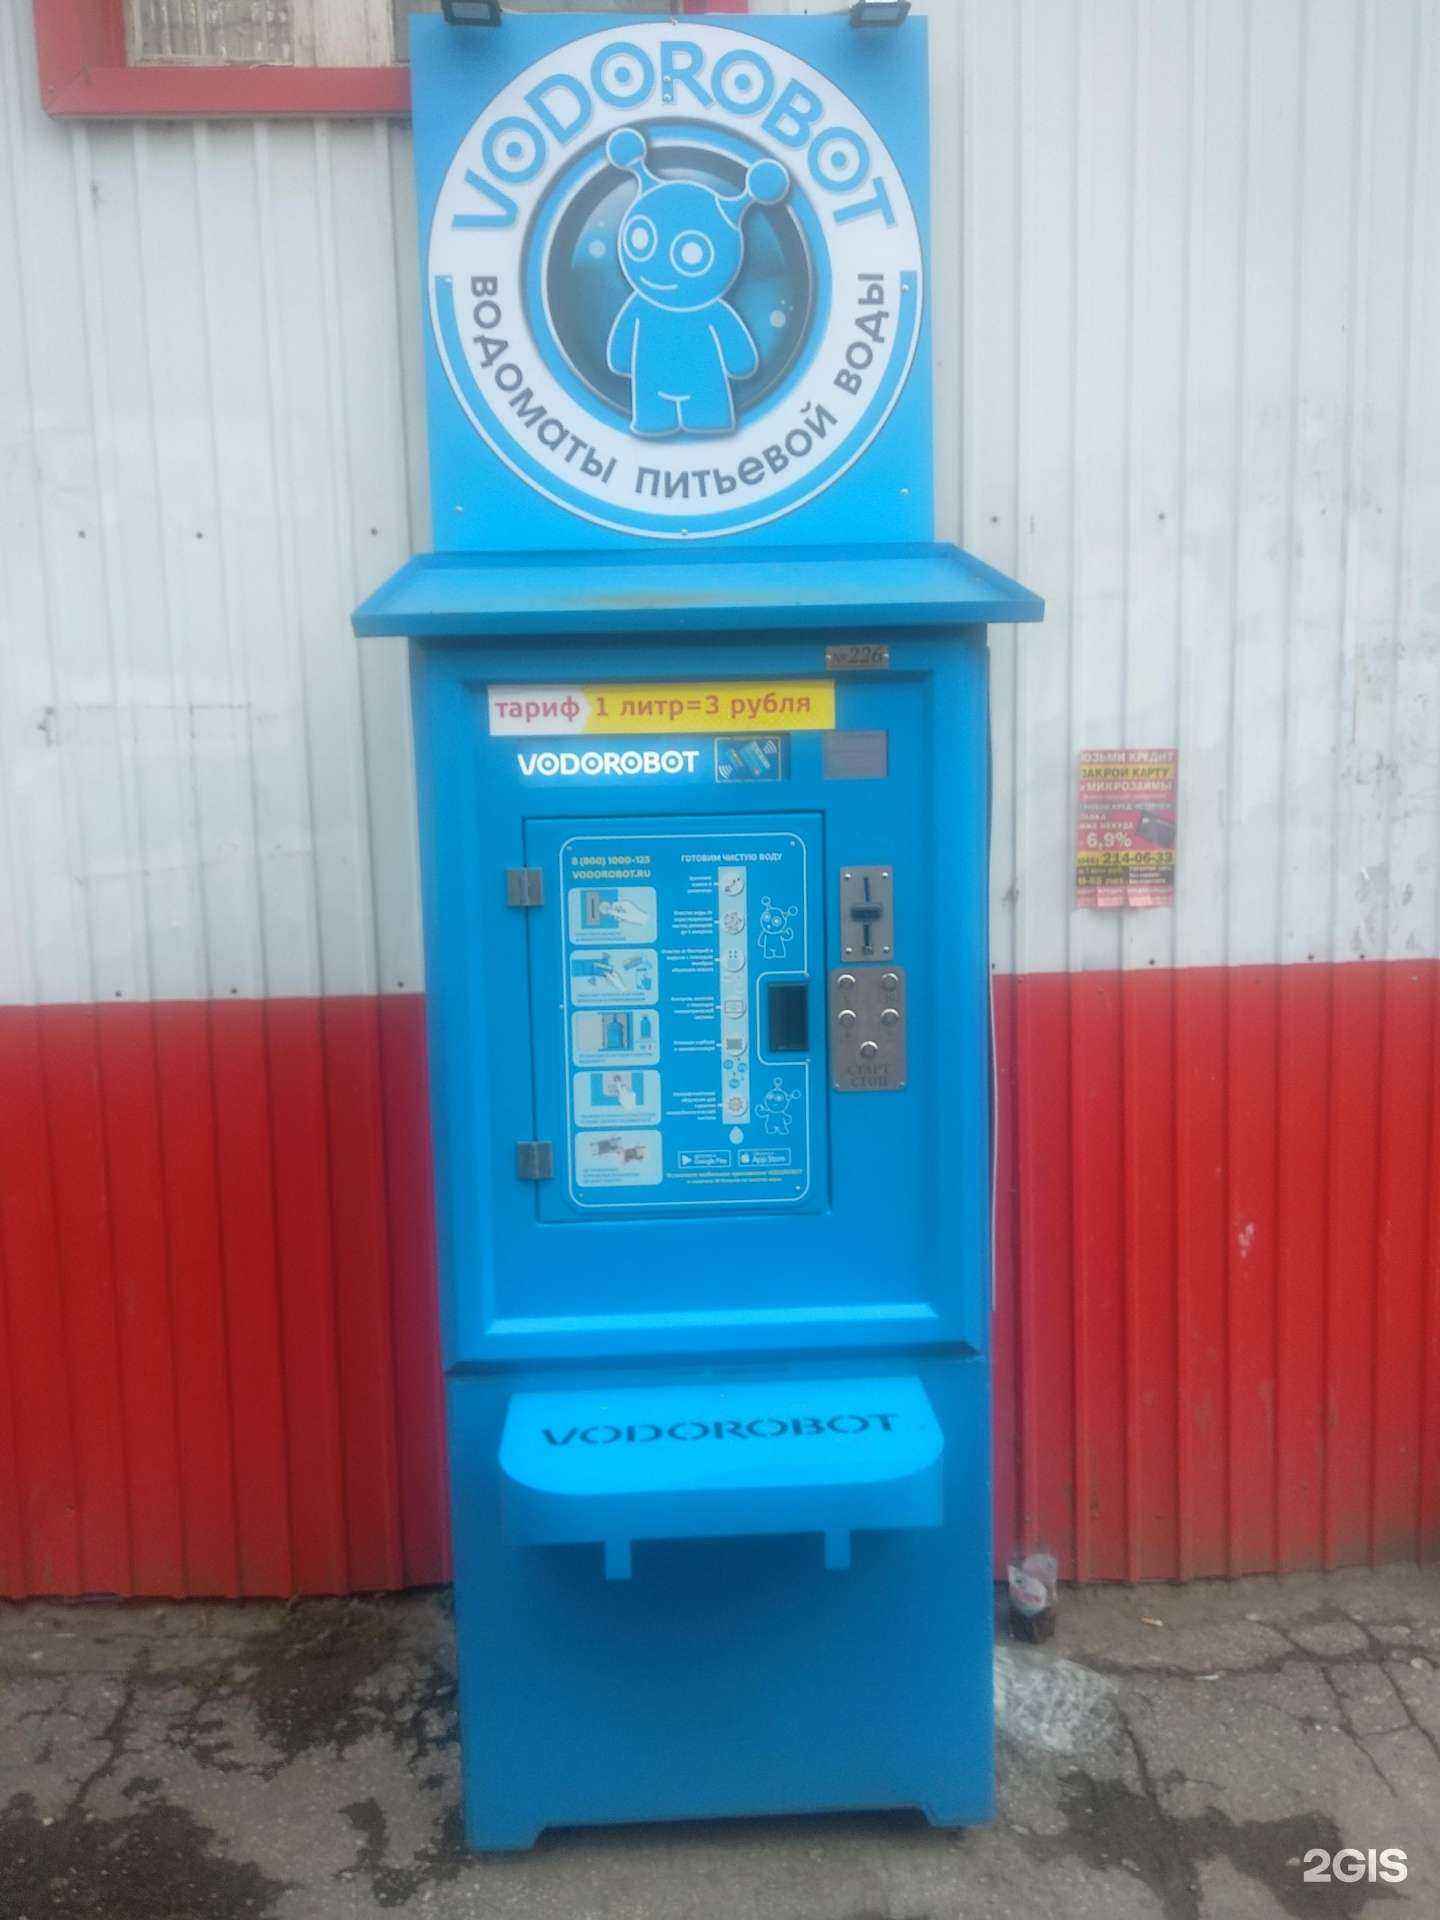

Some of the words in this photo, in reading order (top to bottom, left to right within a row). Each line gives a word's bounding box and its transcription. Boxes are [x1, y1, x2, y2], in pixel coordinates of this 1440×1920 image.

[451, 40, 897, 231] VODOROBOT
[494, 695, 580, 722] тариф
[596, 698, 607, 716] 1
[620, 694, 720, 721] литр=3
[731, 692, 811, 719] рубля
[517, 750, 700, 776] VODOROBOT
[1087, 832, 1132, 849] 6,9%
[608, 855, 650, 864] 1000-123
[541, 1413, 899, 1446] VODOROBOT
